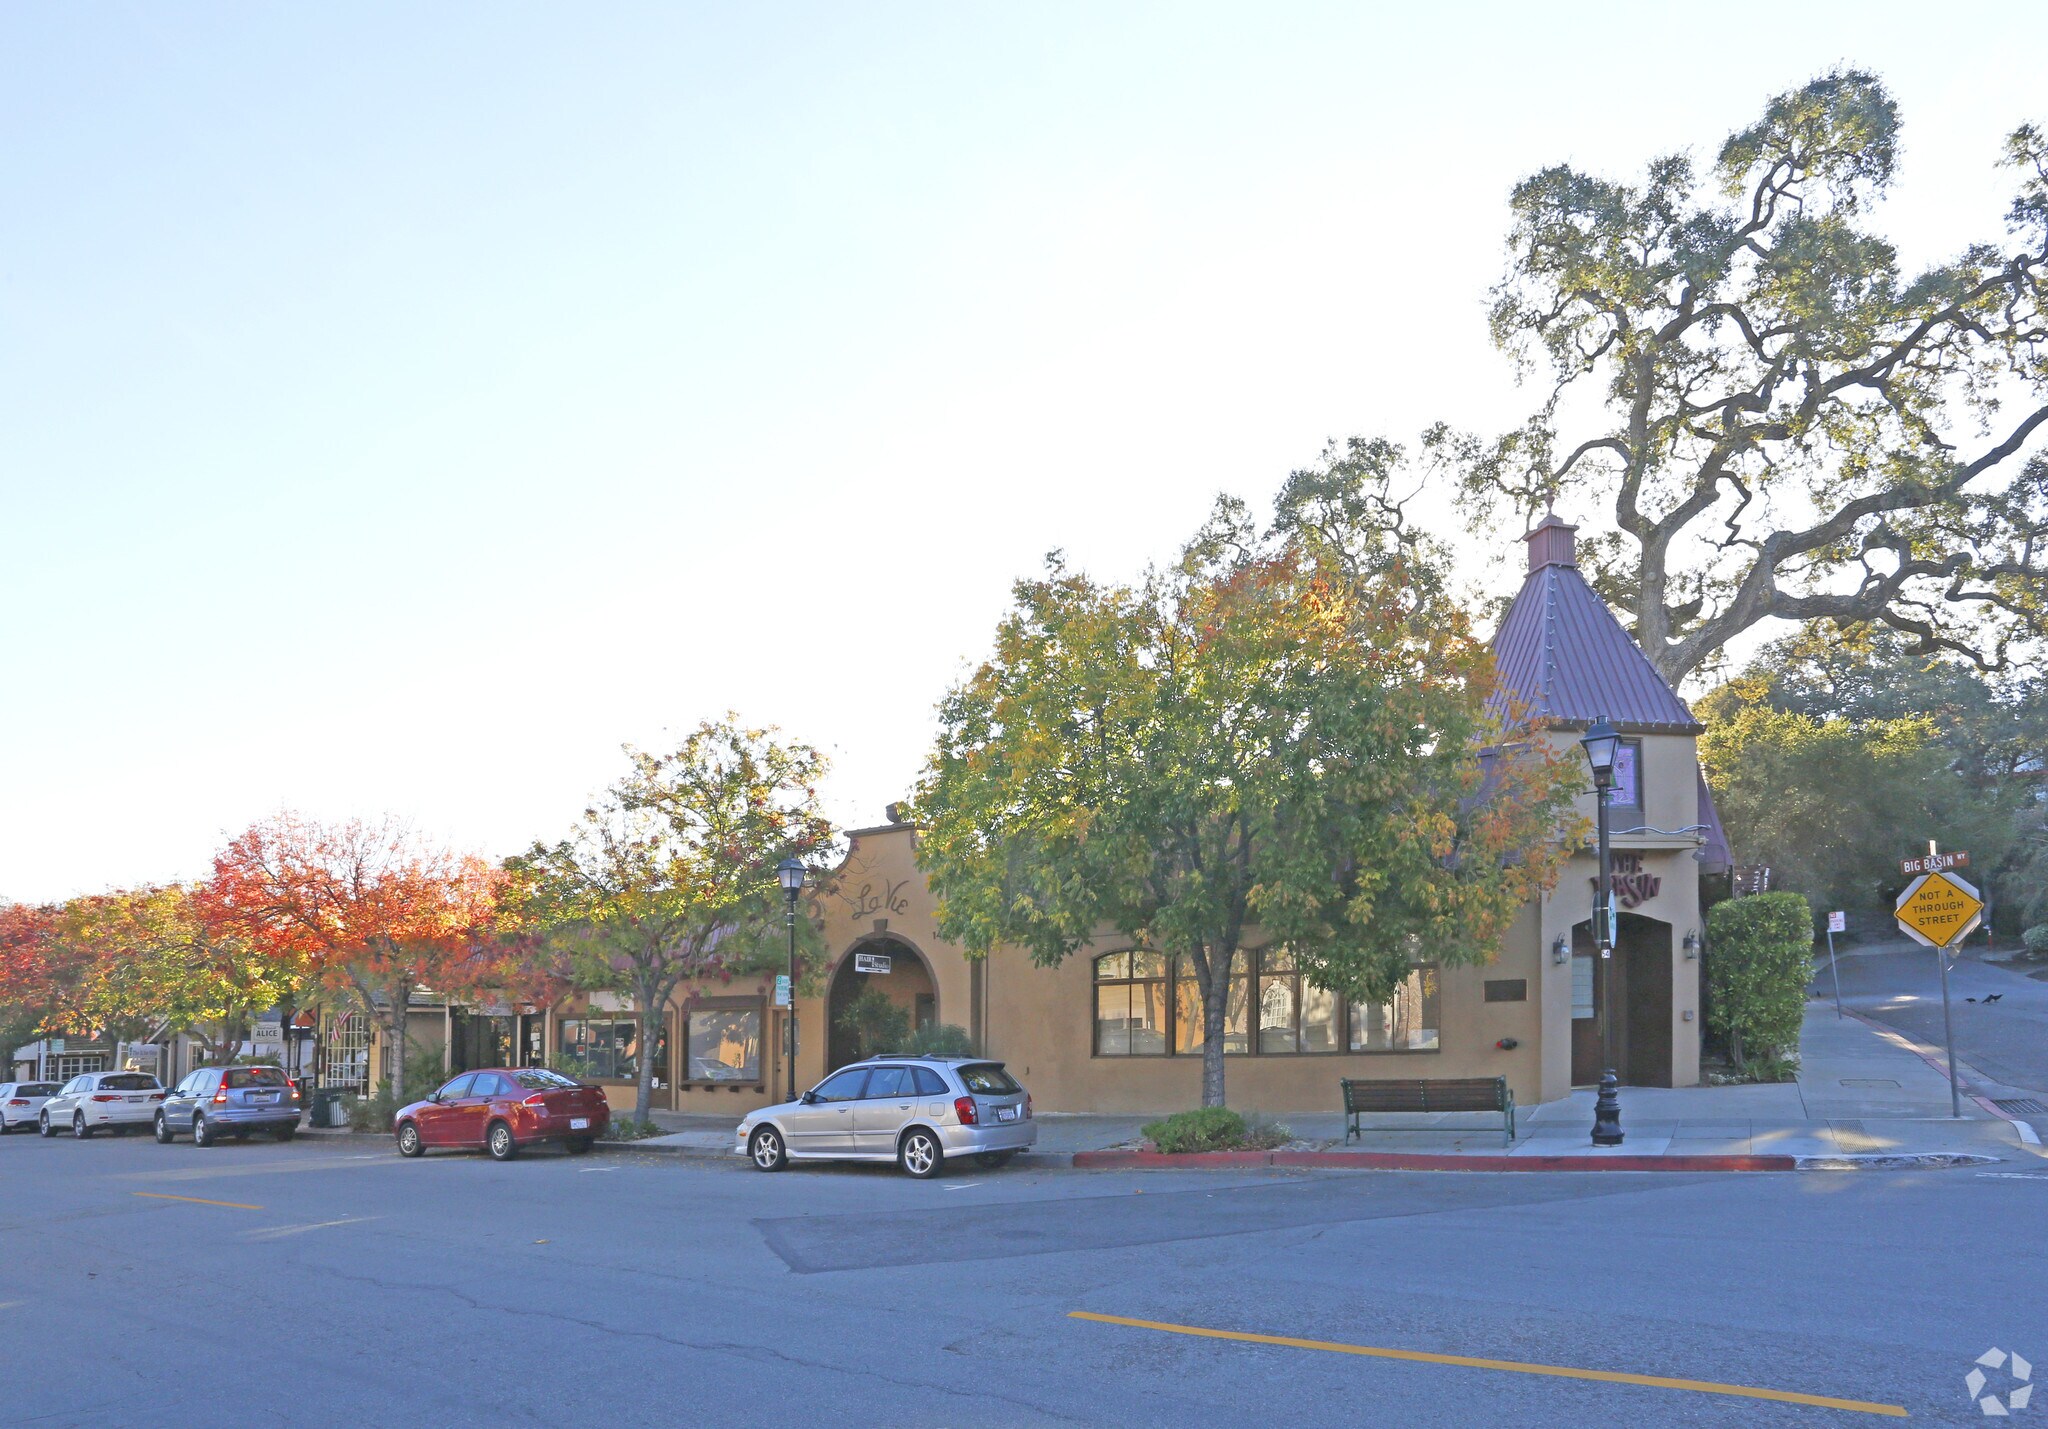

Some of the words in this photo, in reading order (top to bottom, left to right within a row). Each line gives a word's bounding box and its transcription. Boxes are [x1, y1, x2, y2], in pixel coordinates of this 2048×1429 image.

[1904, 860, 1921, 873] BIG
[1923, 855, 1954, 870] BASIN
[1919, 891, 1940, 901] NOT
[1946, 889, 1954, 898] A
[852, 883, 882, 920] La
[1912, 901, 1964, 914] THROUGH
[1918, 914, 1960, 926] STREET
[777, 976, 782, 985] 2
